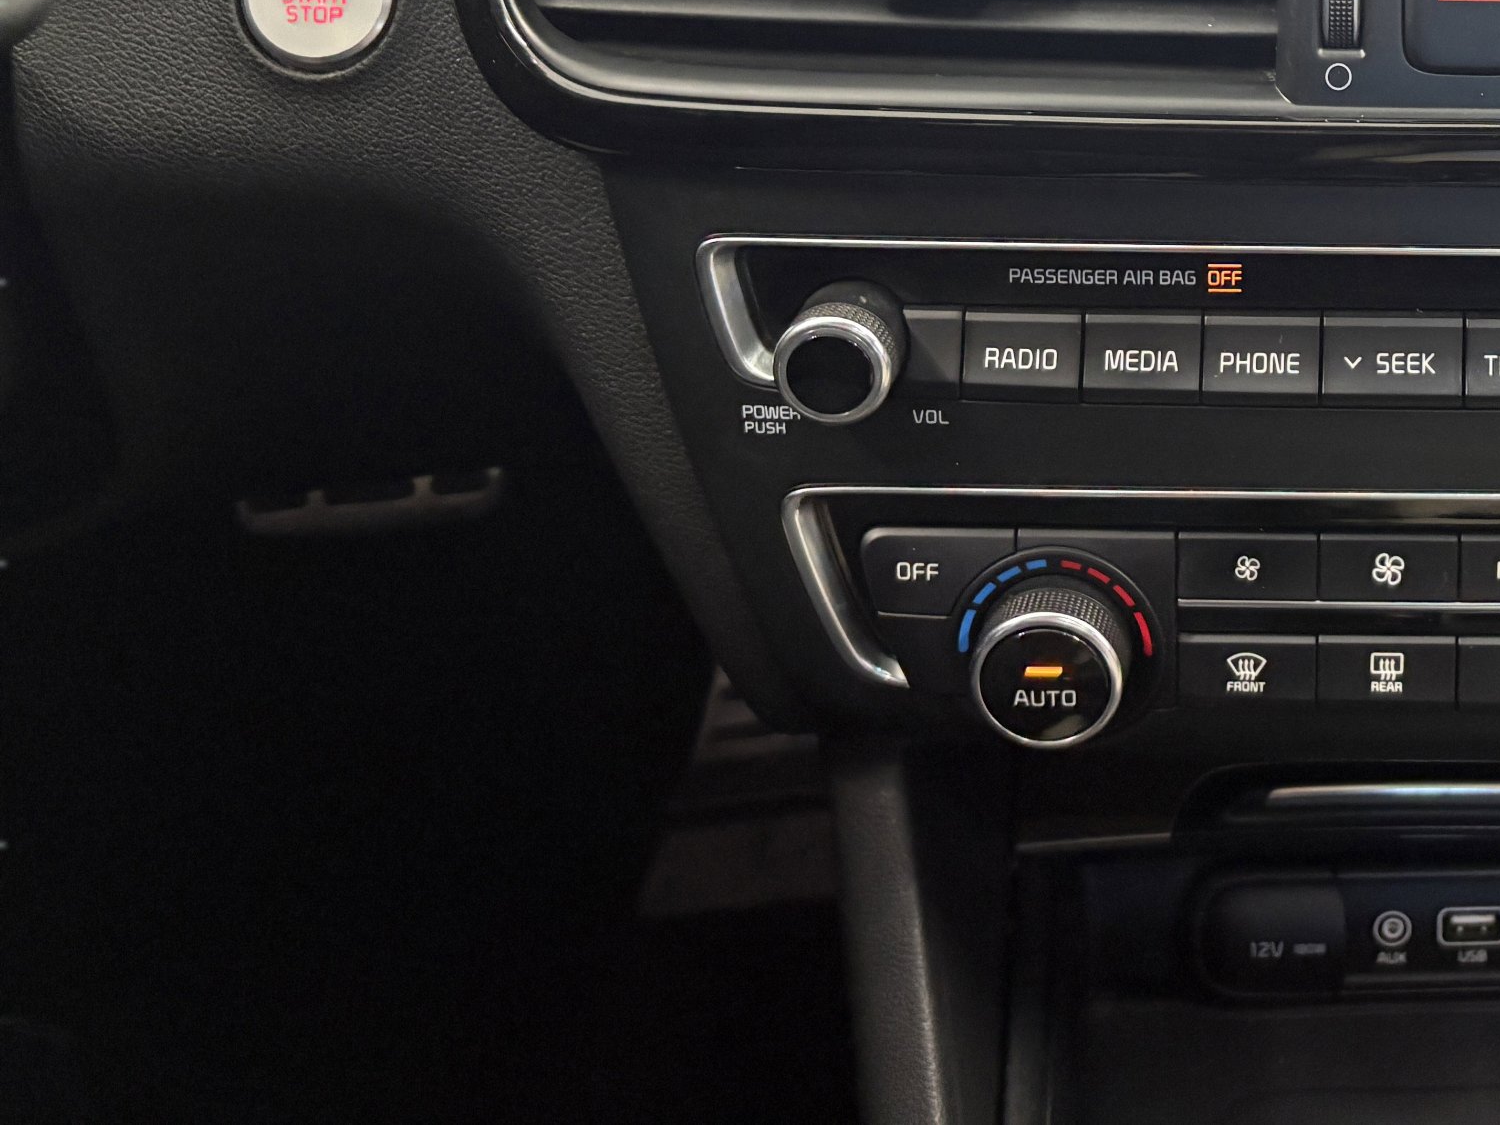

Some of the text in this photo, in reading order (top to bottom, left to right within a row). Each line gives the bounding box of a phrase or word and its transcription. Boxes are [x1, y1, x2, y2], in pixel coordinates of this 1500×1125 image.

[286, 6, 344, 24] STOP
[1009, 268, 1242, 287] PASSENGER AIR BAG OFF
[984, 348, 1058, 370] RADIO
[1105, 350, 1178, 372] MEDIA
[1219, 352, 1300, 374] PHONE
[1376, 353, 1435, 374] SEEK
[912, 409, 950, 425] VOL
[744, 422, 787, 434] PUSH
[896, 562, 939, 580] OFF
[1226, 681, 1266, 693] FRONT
[1371, 682, 1404, 693] REAR
[1013, 689, 1077, 708] AUTO
[1249, 941, 1284, 958] 12V
[1457, 949, 1488, 963] USB
